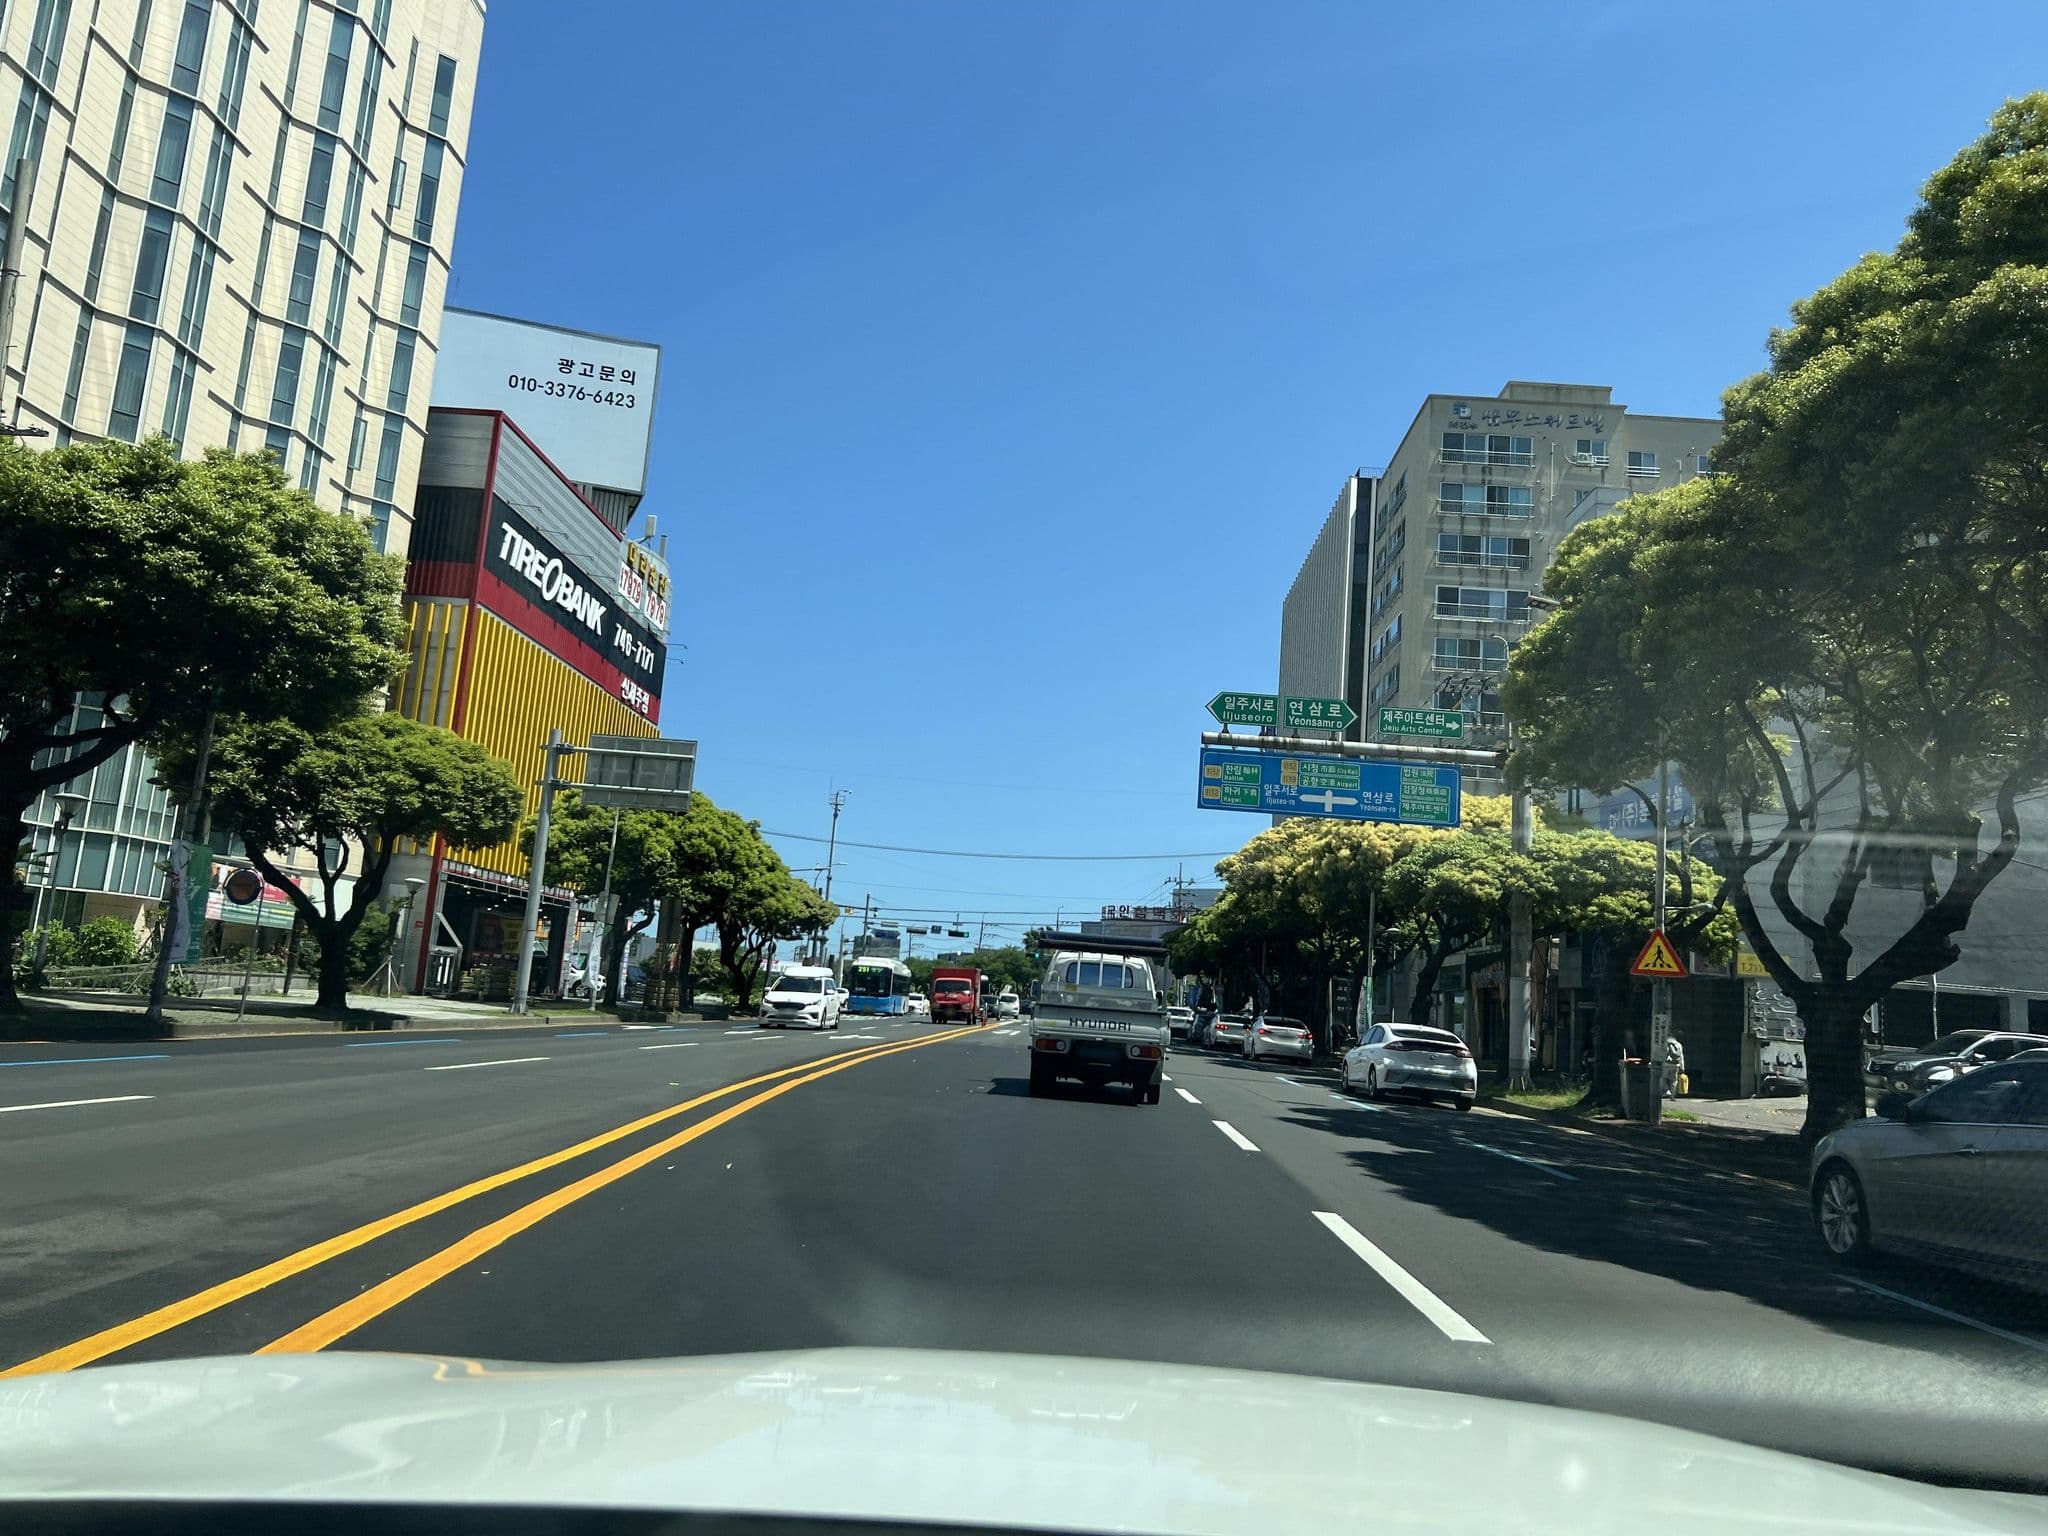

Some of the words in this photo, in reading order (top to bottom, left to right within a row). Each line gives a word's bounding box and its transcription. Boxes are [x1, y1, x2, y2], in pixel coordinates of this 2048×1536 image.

[558, 358, 636, 385] 광고문의
[508, 374, 635, 408] 010-3376-6423
[614, 623, 655, 673] 746-7171
[1224, 696, 1275, 711] 일주서로
[1288, 716, 1343, 729] Yeonsamro
[1383, 710, 1445, 726] 제주아트센터
[1383, 724, 1399, 732] Jeju
[1401, 725, 1415, 733] Arts
[1417, 726, 1443, 735] Center
[1263, 783, 1299, 796] 일주서로
[1362, 791, 1394, 804] 연삼로
[1402, 802, 1448, 814] 제주아트센터
[1069, 1017, 1132, 1032] HYUNDAI
